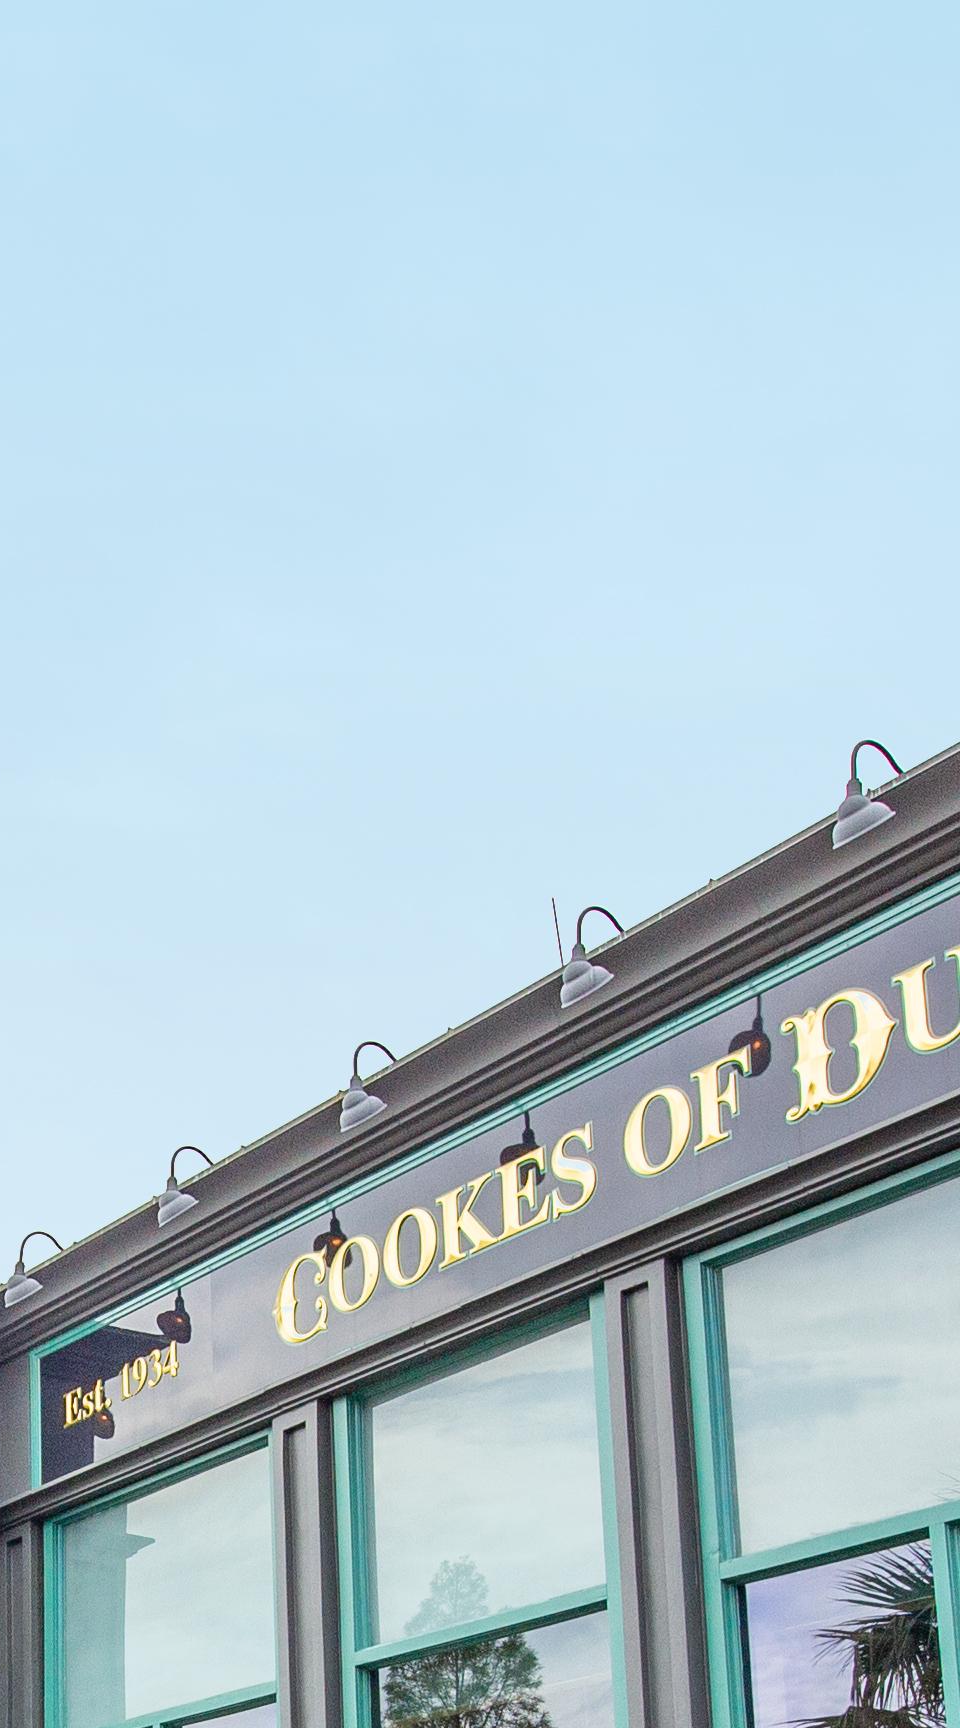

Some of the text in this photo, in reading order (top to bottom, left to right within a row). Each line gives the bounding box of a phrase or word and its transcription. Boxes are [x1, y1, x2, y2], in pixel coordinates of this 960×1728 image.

[271, 1121, 598, 1344] COOKES
[623, 1044, 755, 1178] OF
[62, 1340, 180, 1429] Est. 1934
